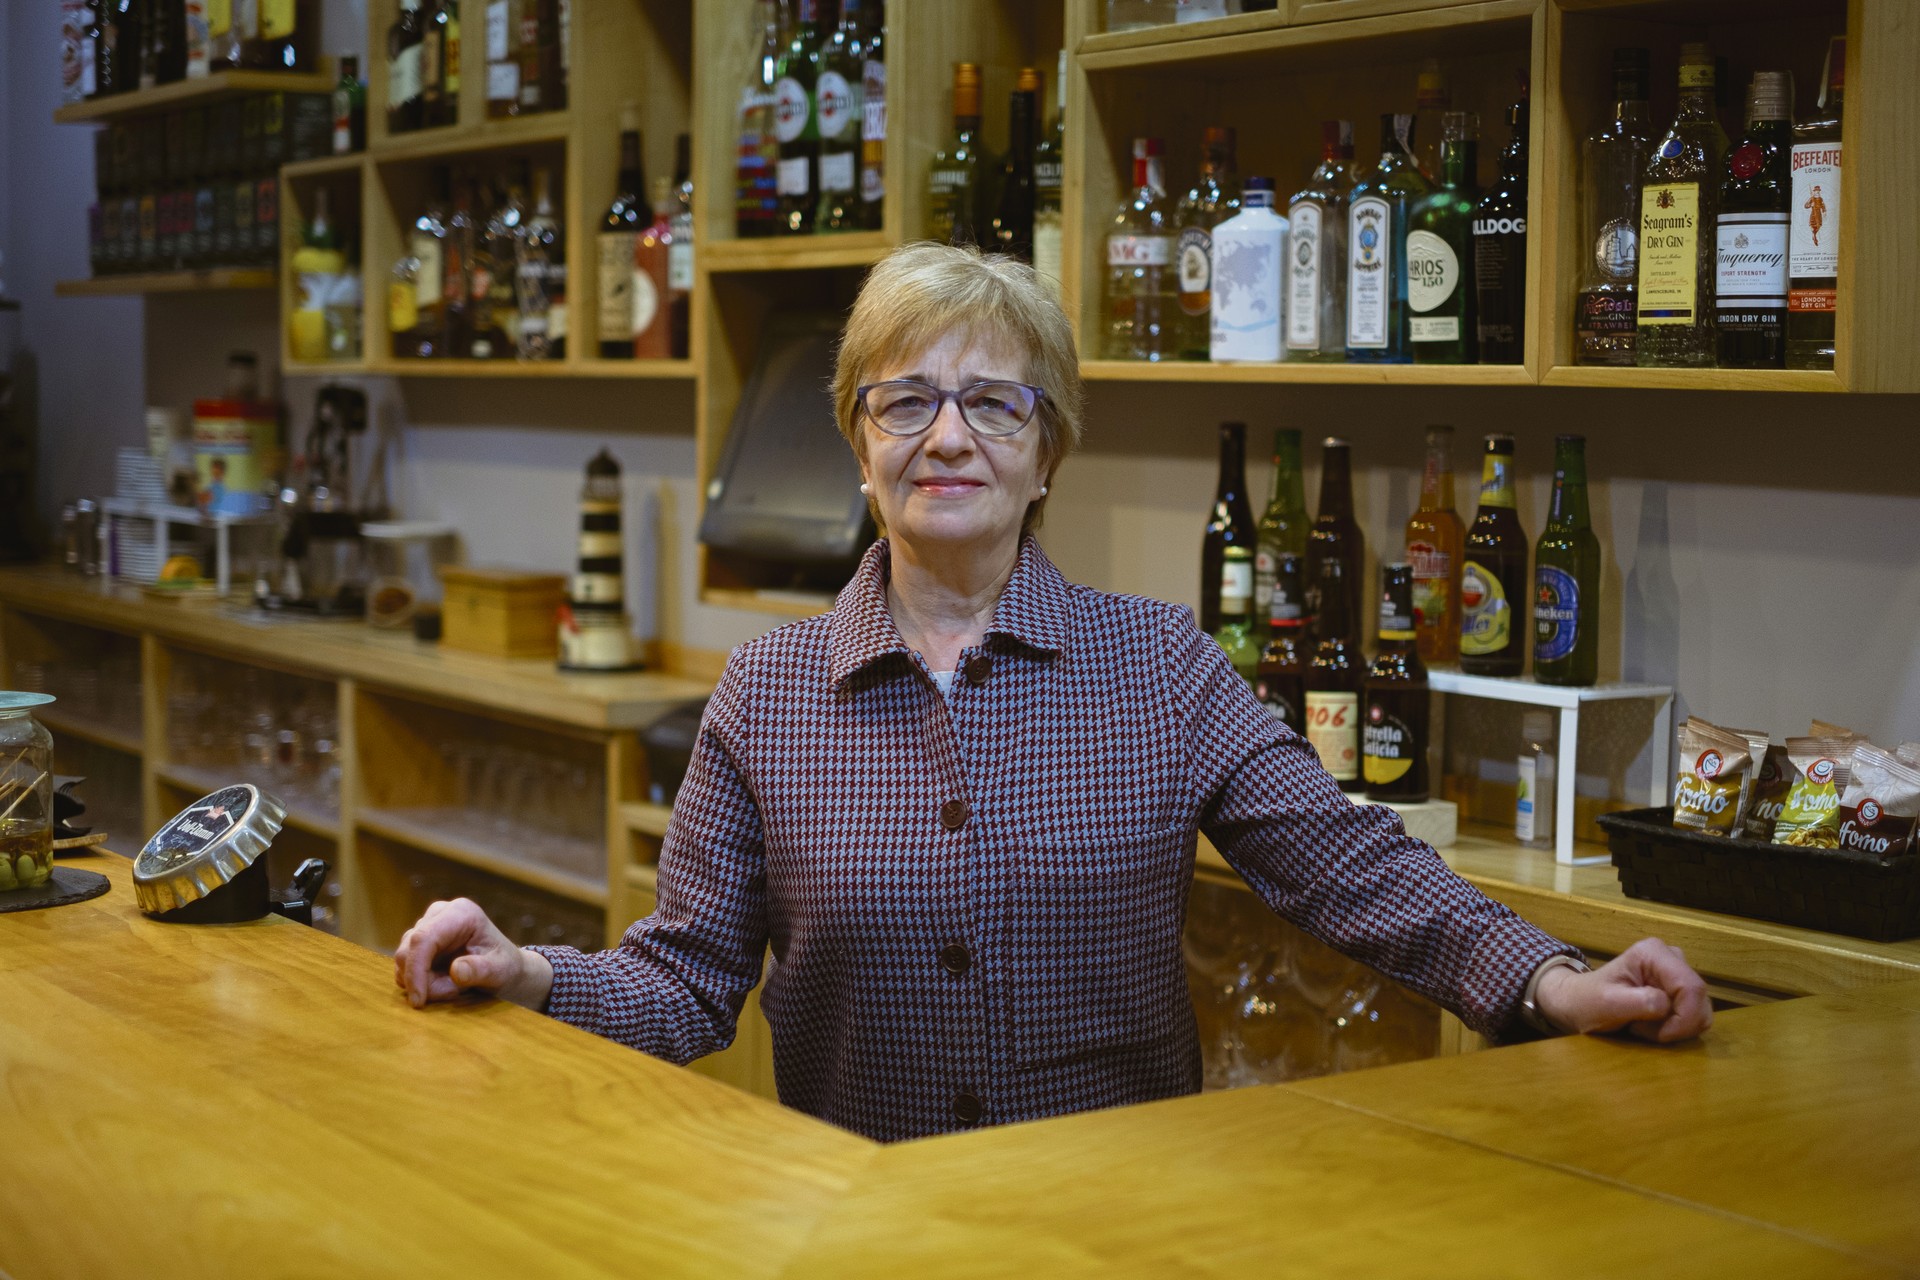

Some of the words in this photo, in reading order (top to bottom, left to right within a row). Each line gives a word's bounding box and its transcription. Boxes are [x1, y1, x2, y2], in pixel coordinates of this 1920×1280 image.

[1643, 213, 1693, 232] Seagram's
[1647, 235, 1665, 249] DRY
[1666, 235, 1684, 248] GIN
[1718, 248, 1783, 268] Tanqueray
[1409, 259, 1444, 276] ARIOS
[1422, 276, 1443, 287] 150
[1608, 313, 1626, 321] GIN
[1742, 315, 1759, 323] DRY
[1762, 315, 1777, 323] GIN
